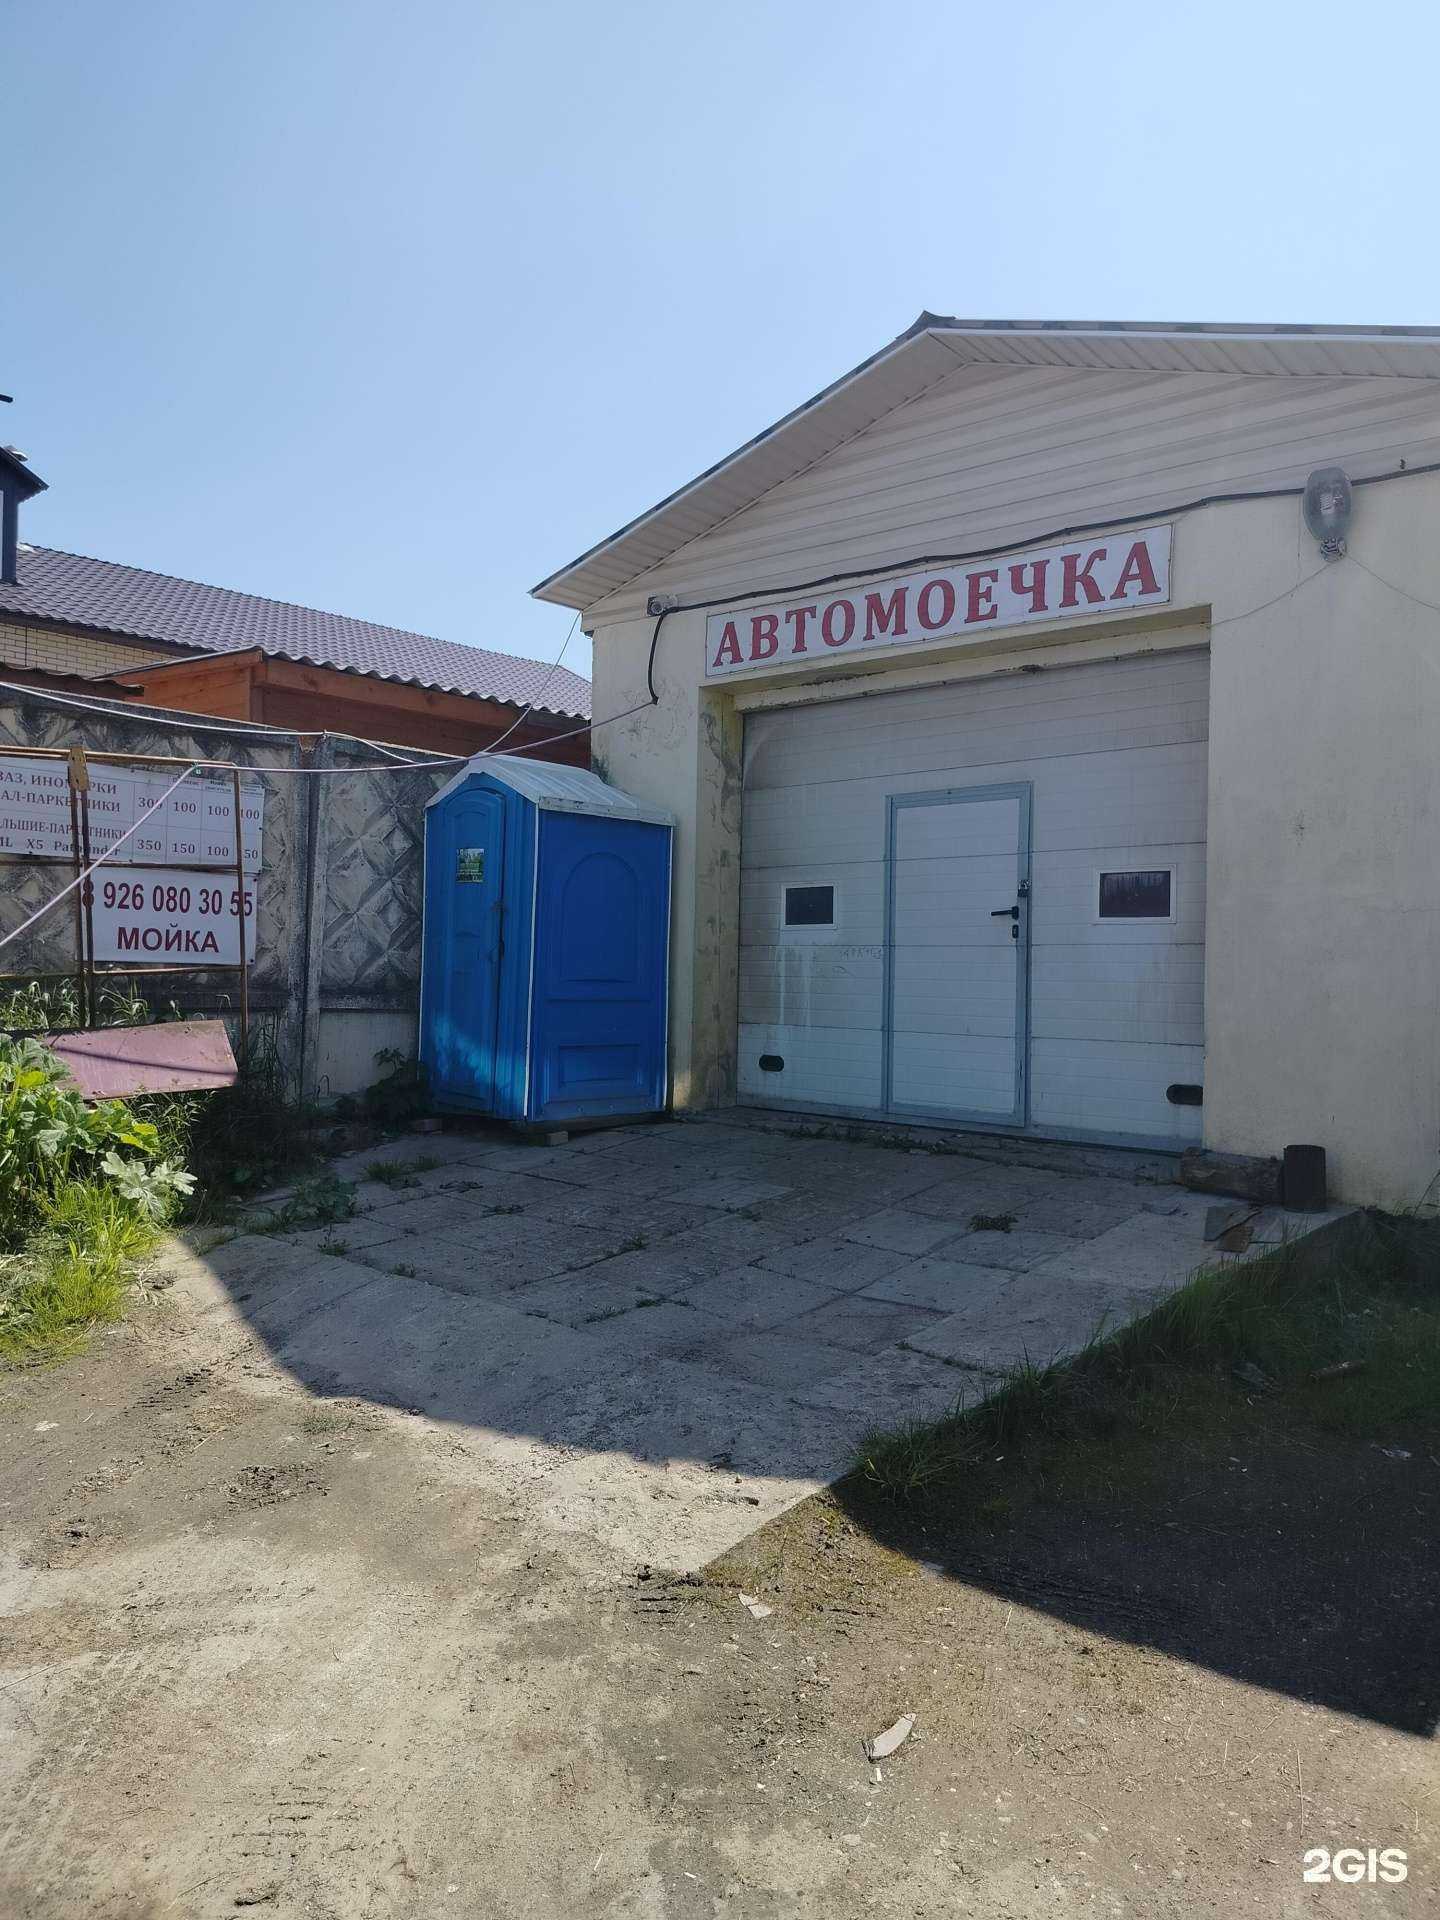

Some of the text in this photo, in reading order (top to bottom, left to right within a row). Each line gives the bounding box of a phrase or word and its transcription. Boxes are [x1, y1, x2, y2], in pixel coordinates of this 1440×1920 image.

[712, 541, 1162, 667] АВТОМОЕЧКА
[174, 802, 197, 813] 100
[208, 806, 230, 817] 100
[137, 839, 162, 850] 350
[172, 843, 195, 854] 150
[207, 846, 229, 857] 100
[103, 882, 144, 911] 926
[152, 885, 191, 913] 080
[198, 889, 223, 915] 30
[229, 891, 253, 917] 55
[117, 922, 220, 953] МОЙКА
